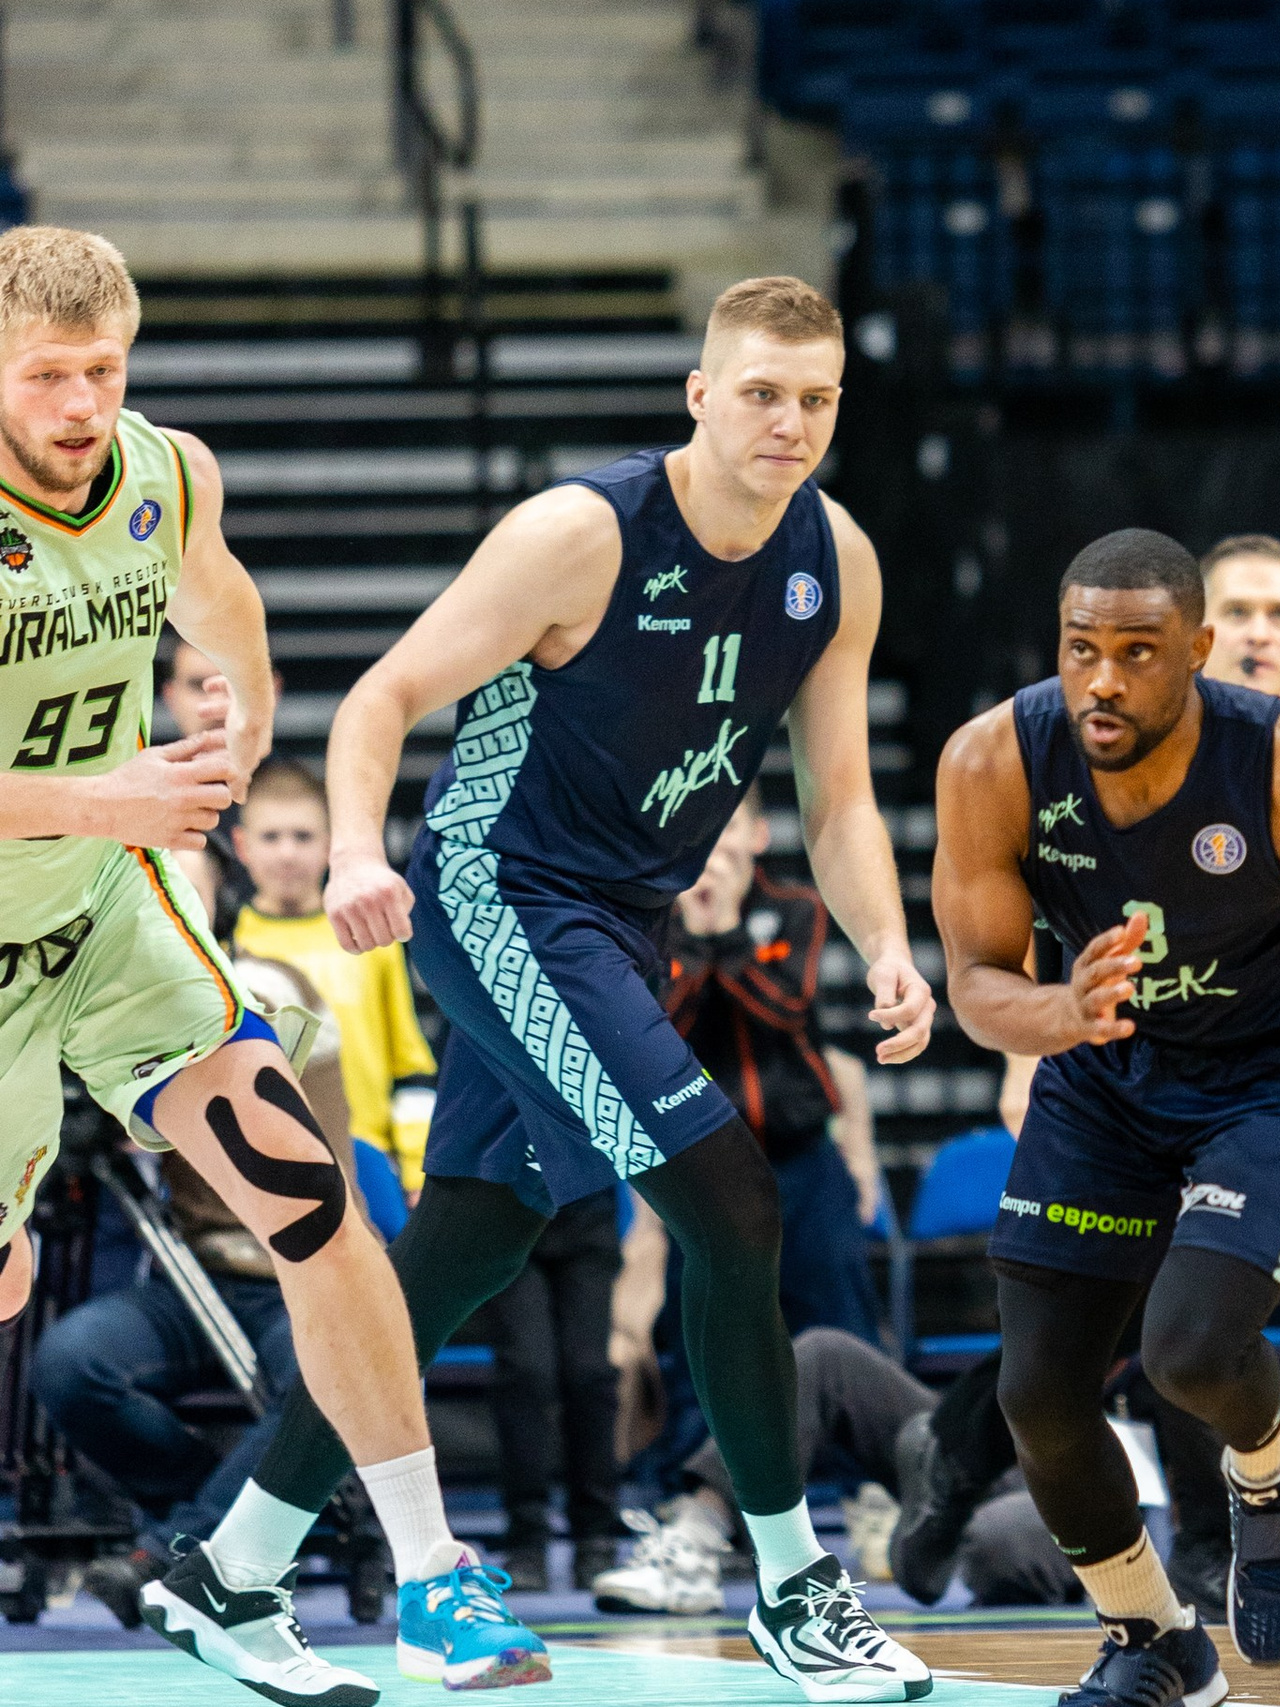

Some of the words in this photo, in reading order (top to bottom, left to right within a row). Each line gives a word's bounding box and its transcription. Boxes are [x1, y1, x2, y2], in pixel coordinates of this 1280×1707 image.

[637, 614, 691, 635] Kempa
[697, 633, 742, 703] 11
[10, 679, 131, 770] 93
[1038, 842, 1097, 873] Kempa
[651, 1074, 709, 1115] Kempa
